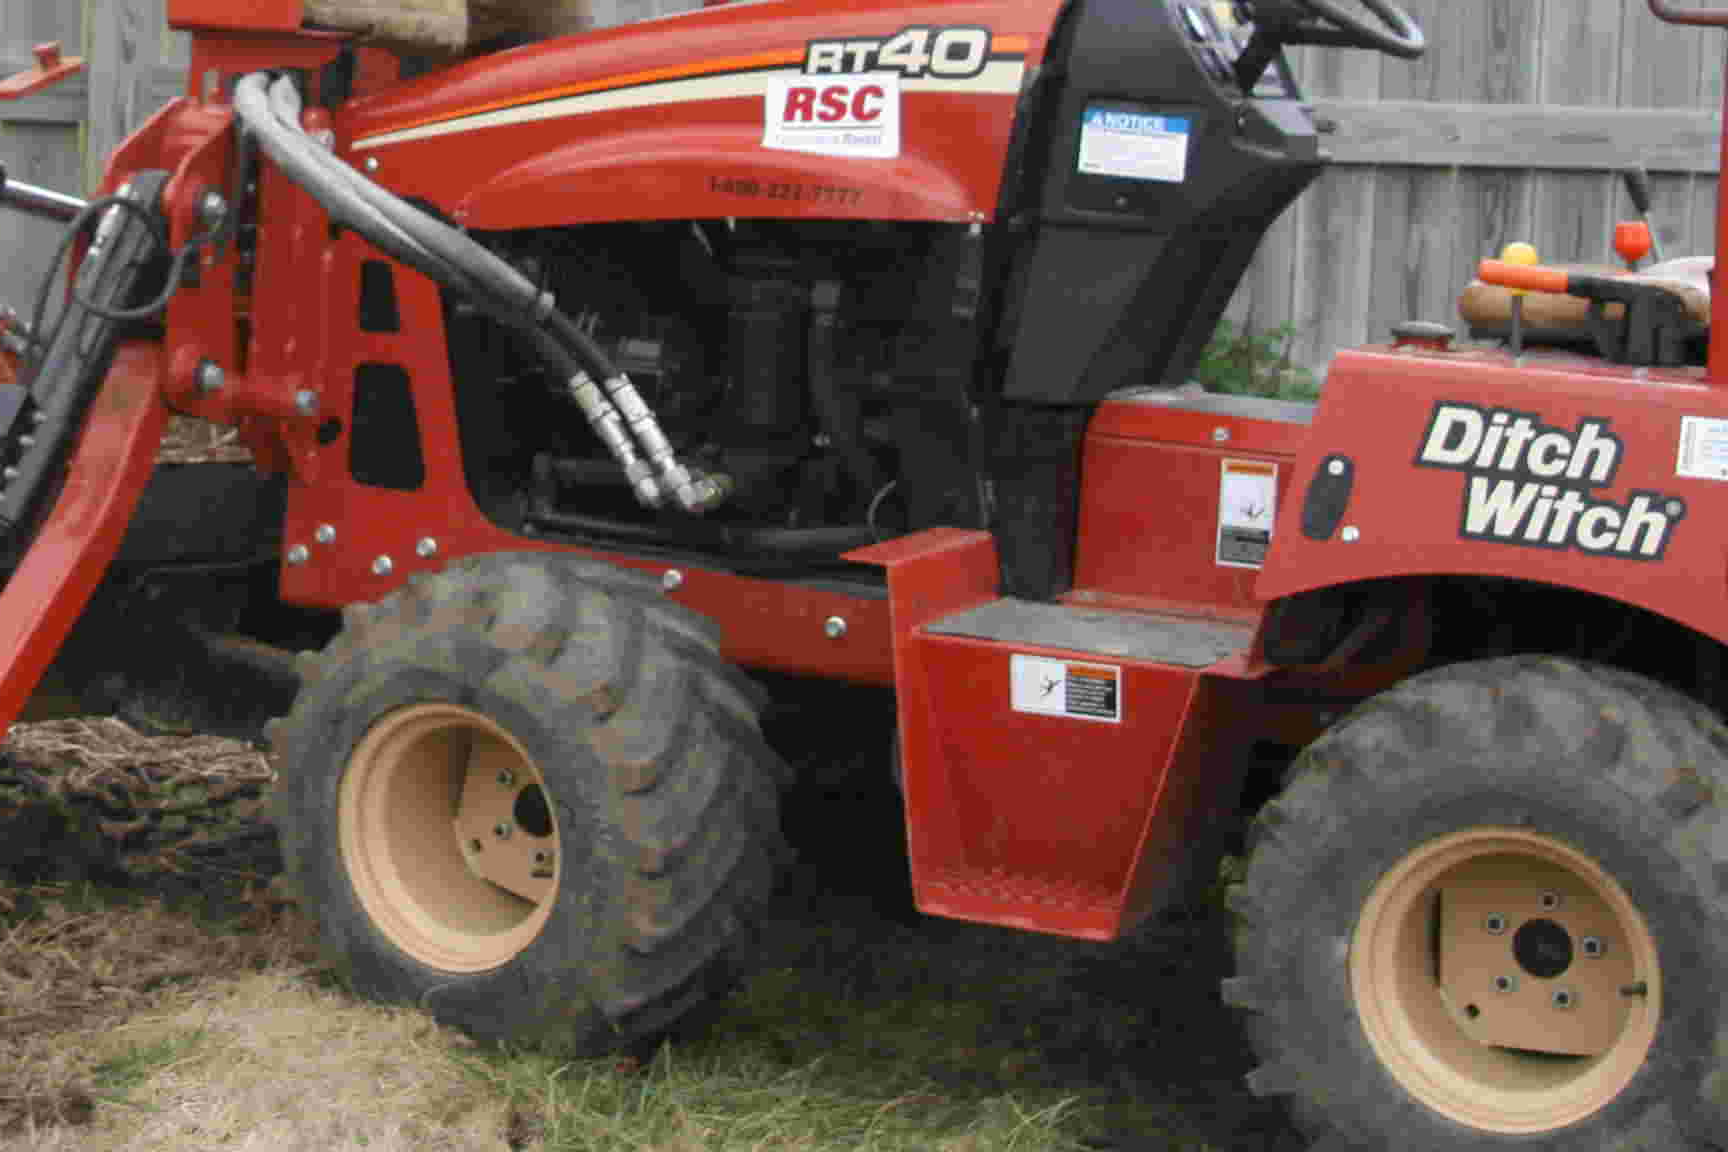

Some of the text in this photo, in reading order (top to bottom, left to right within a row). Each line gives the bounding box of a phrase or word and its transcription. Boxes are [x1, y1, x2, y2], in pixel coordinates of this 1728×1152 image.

[805, 27, 988, 78] RT40
[783, 84, 885, 123] RSC
[1419, 404, 1620, 483] Ditch
[1463, 475, 1669, 557] Witch
